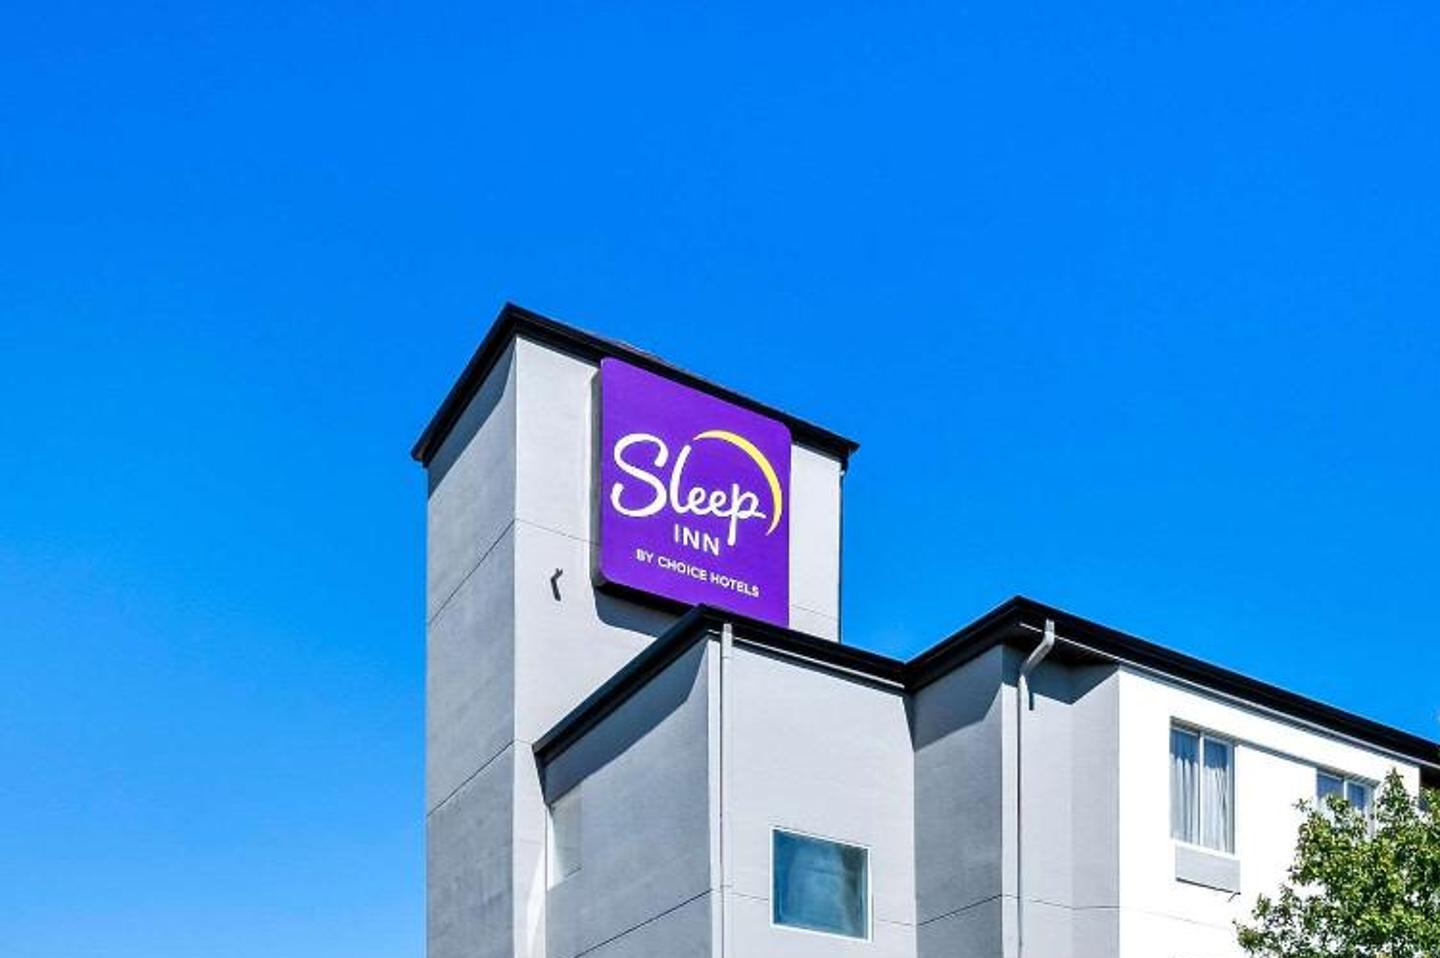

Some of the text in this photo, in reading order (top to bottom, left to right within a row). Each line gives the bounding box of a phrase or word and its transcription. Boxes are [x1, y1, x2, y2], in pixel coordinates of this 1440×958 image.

[610, 433, 766, 546] Sleep
[674, 524, 720, 556] INN
[636, 549, 760, 598] BY CHOICE HOTELS
